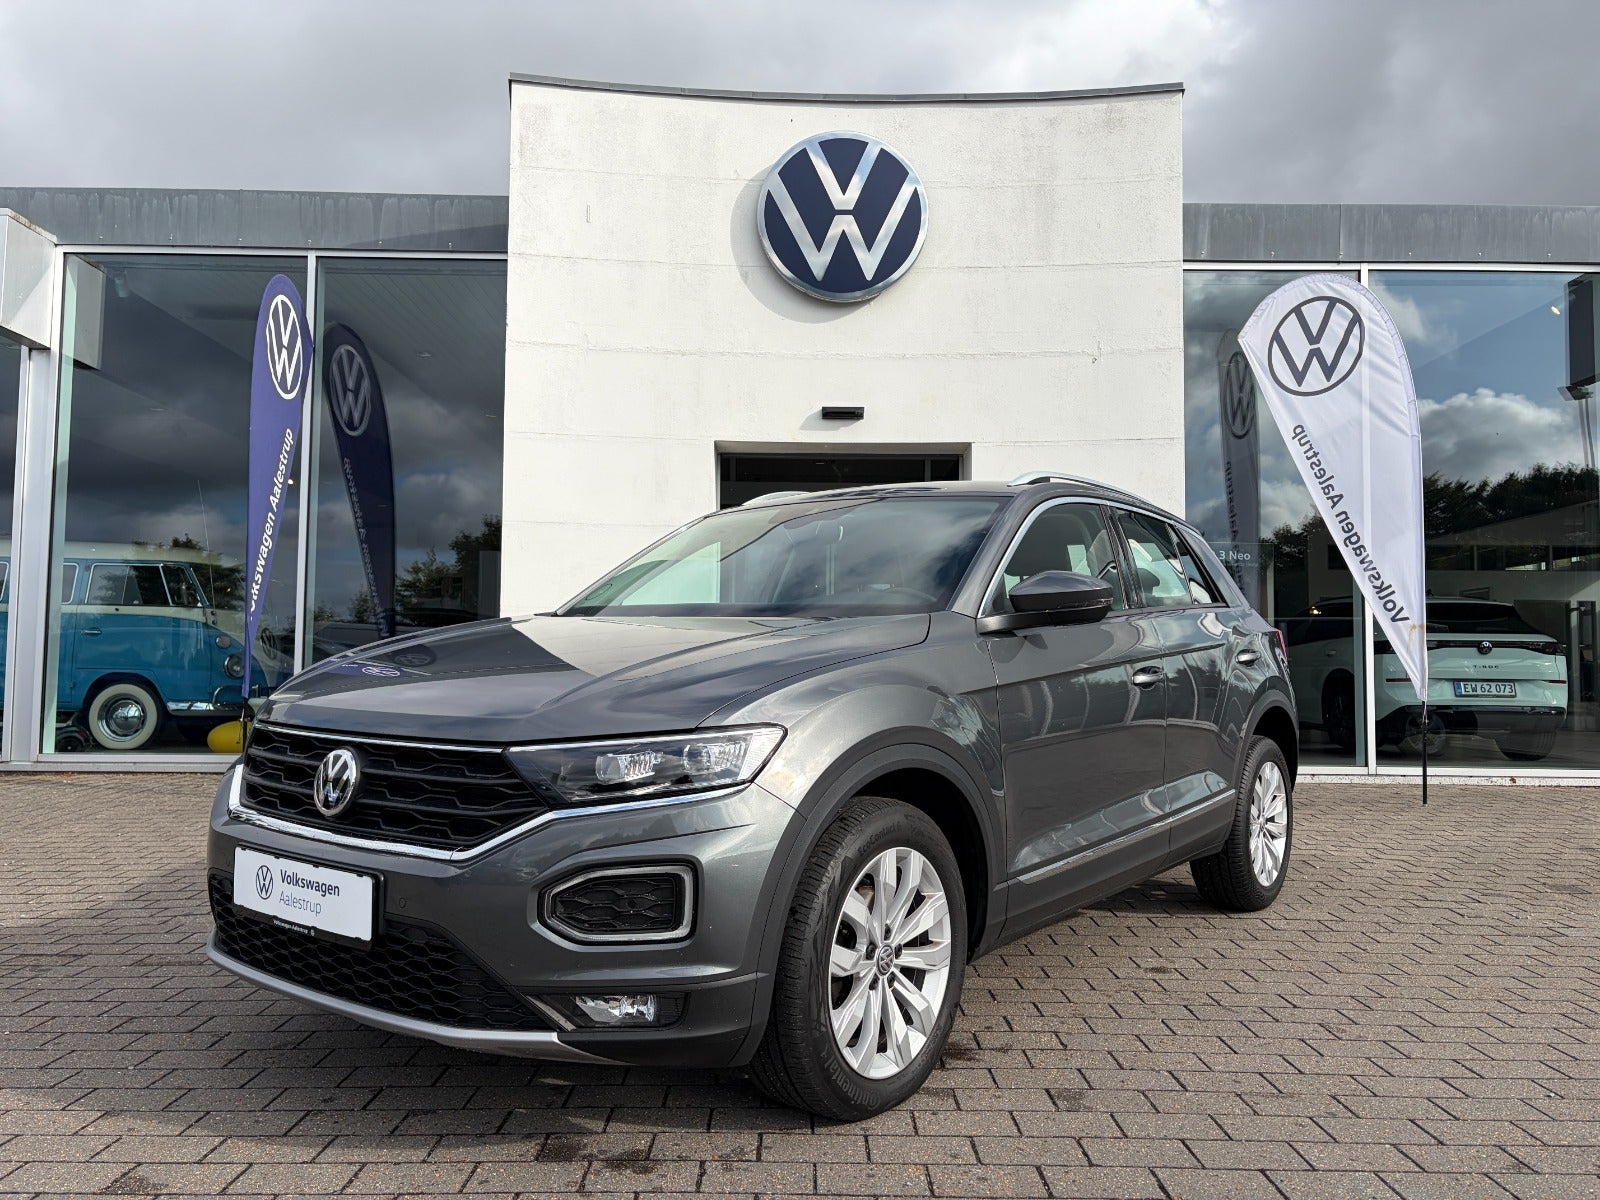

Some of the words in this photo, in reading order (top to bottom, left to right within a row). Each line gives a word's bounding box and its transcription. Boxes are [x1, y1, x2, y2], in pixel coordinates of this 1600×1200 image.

[760, 135, 925, 297] VW
[266, 294, 302, 399] VW
[1268, 296, 1365, 396] VW
[250, 513, 276, 621] lkswagen
[270, 427, 293, 512] Aalestrup
[1229, 550, 1251, 561] Neo
[1463, 683, 1478, 693] EW
[1480, 683, 1492, 693] 62
[1495, 683, 1514, 693] 073
[314, 747, 359, 817] VW
[256, 865, 273, 900] VW
[279, 890, 322, 916] Aalestrup
[280, 869, 340, 897] Volkswagen
[824, 1055, 881, 1111] Continental
